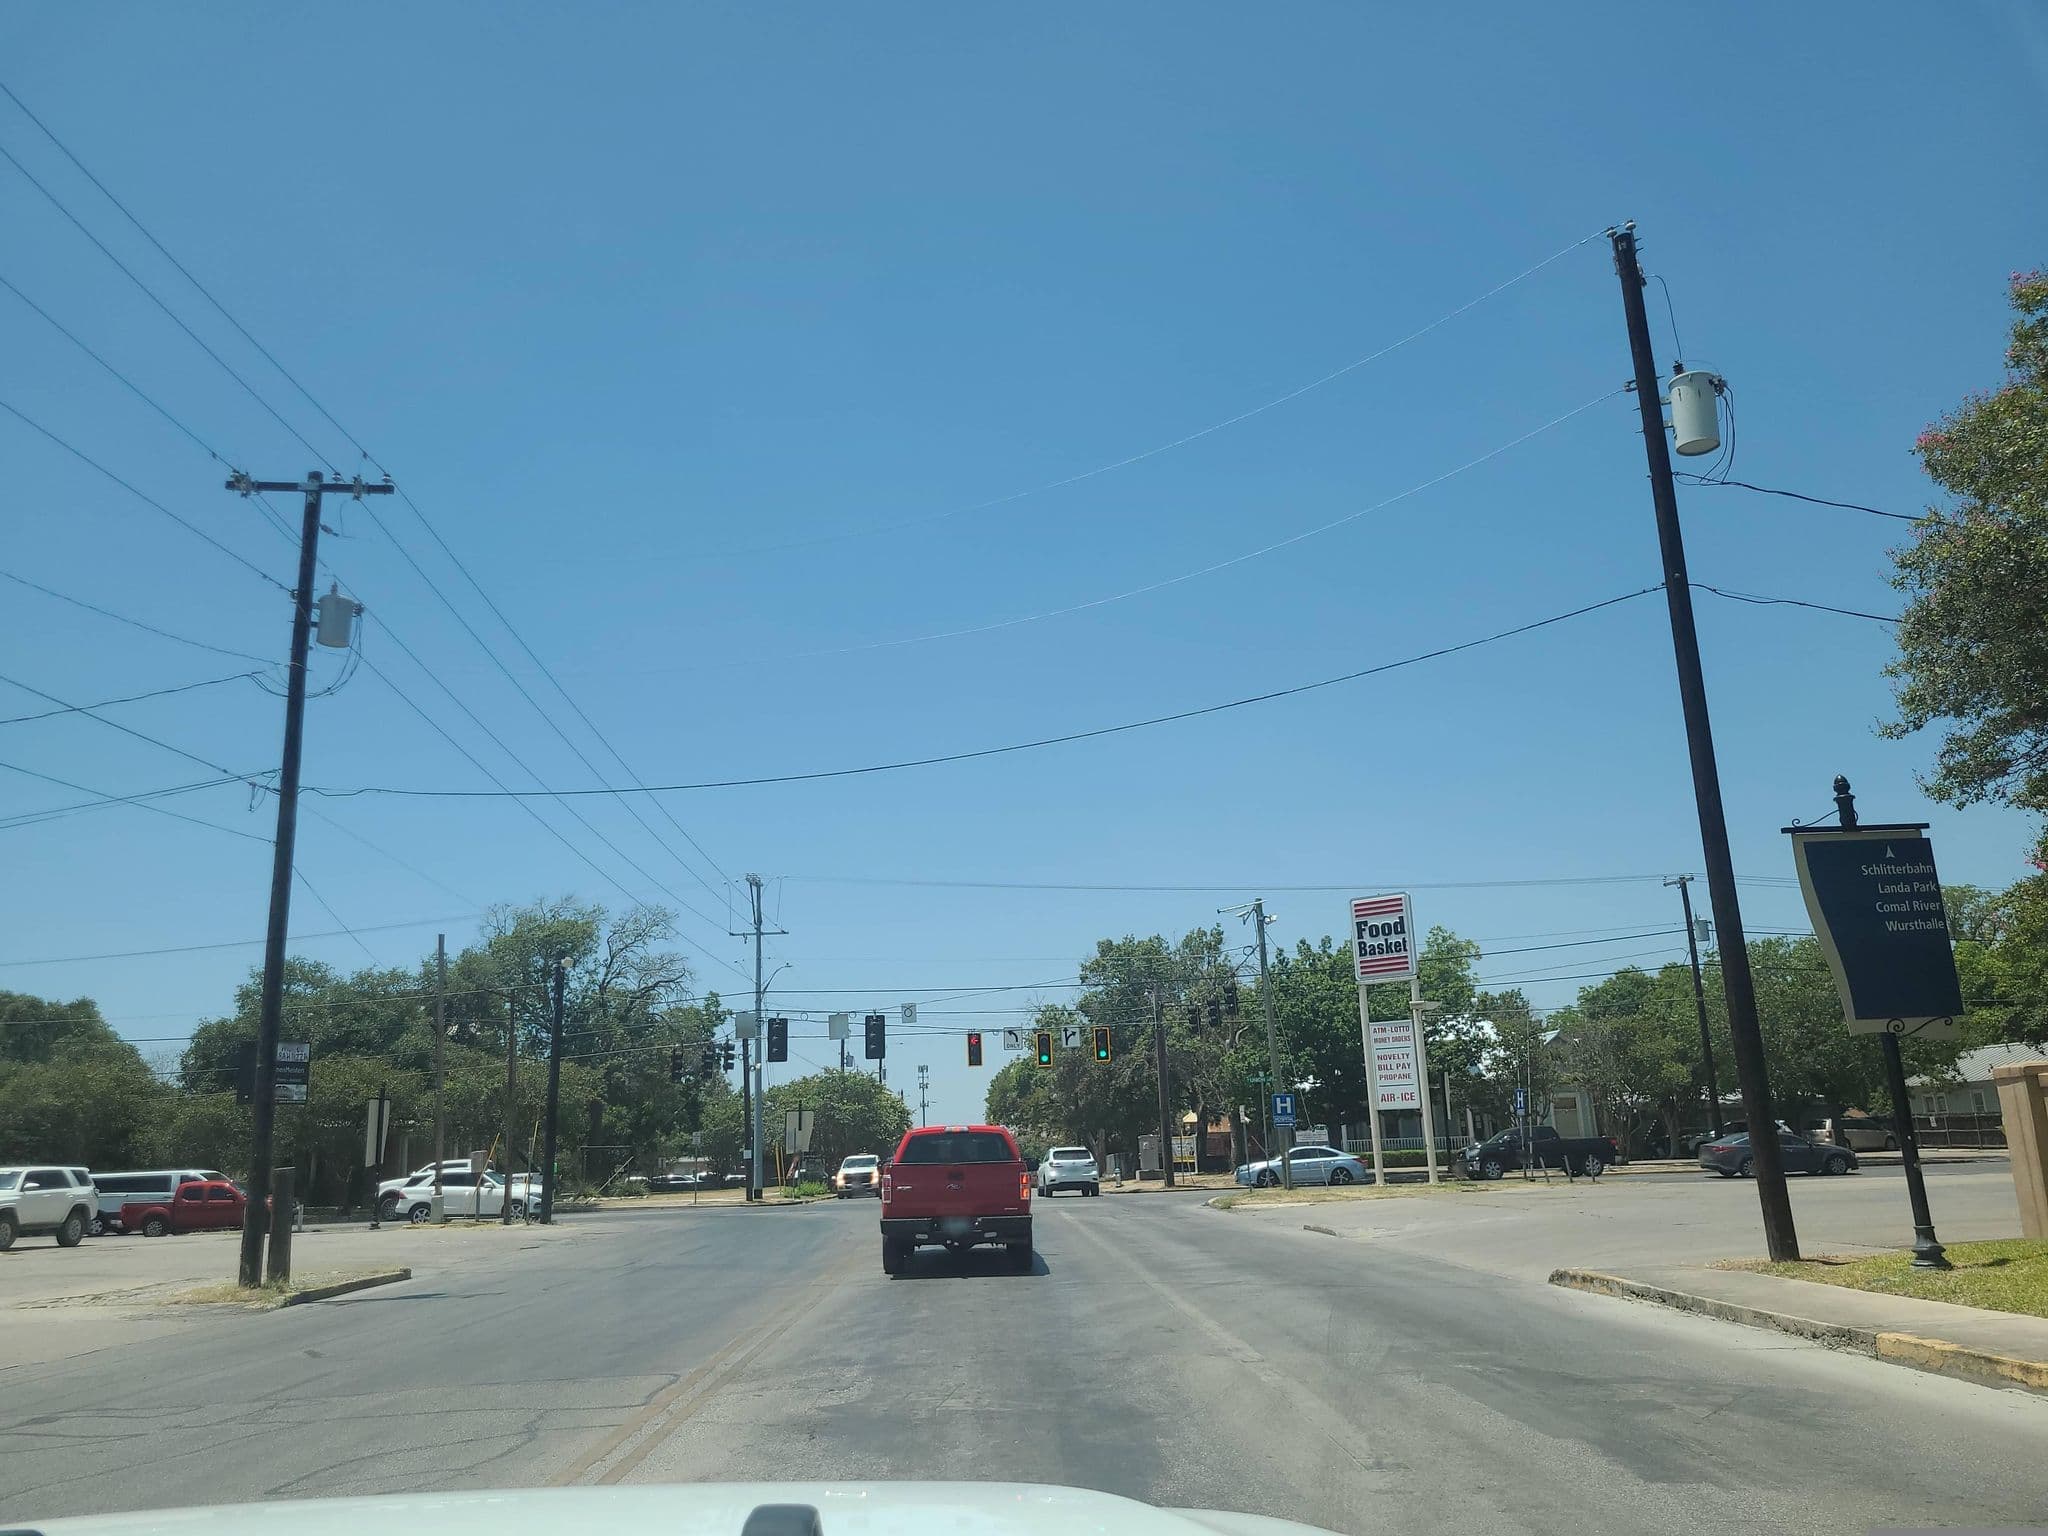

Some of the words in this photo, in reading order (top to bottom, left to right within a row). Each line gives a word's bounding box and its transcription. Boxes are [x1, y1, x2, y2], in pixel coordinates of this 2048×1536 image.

[1861, 863, 1933, 876] Schlitterbahn
[1878, 882, 1910, 894] Landa
[1914, 881, 1937, 892] Park
[1876, 901, 1910, 912] Comal
[1913, 901, 1940, 911] River
[1356, 916, 1406, 940] Food
[1885, 918, 1944, 931] Wursthalle
[1358, 937, 1408, 957] Basket
[1377, 1052, 1410, 1060] NOVELTY
[1276, 1098, 1292, 1114] H
